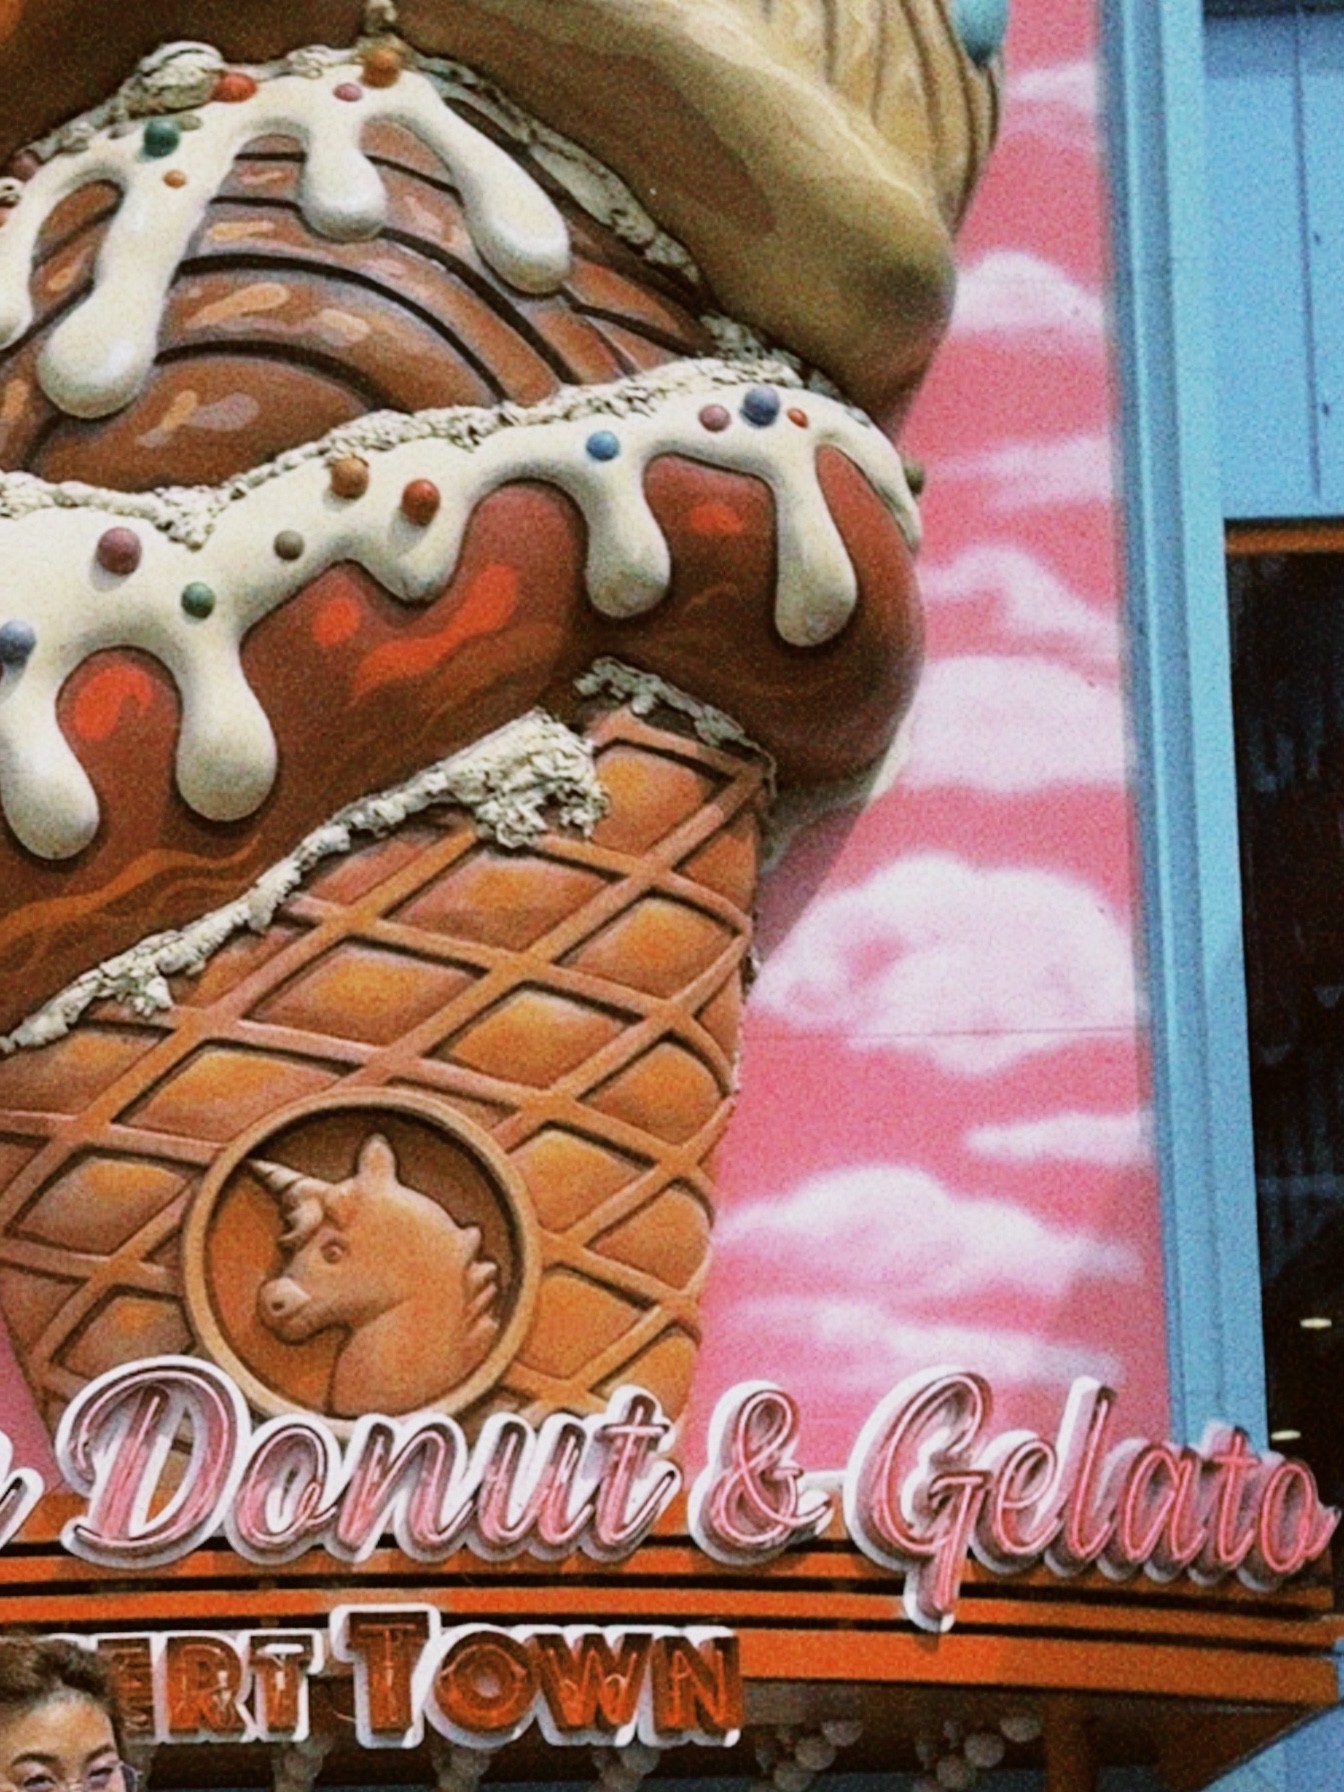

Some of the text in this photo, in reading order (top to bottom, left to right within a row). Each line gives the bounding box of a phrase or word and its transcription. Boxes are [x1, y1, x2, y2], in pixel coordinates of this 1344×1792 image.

[56, 1354, 681, 1568] Donut
[688, 1380, 833, 1566] &
[843, 1365, 1343, 1633] Gelato
[328, 1603, 742, 1748] TOWN
